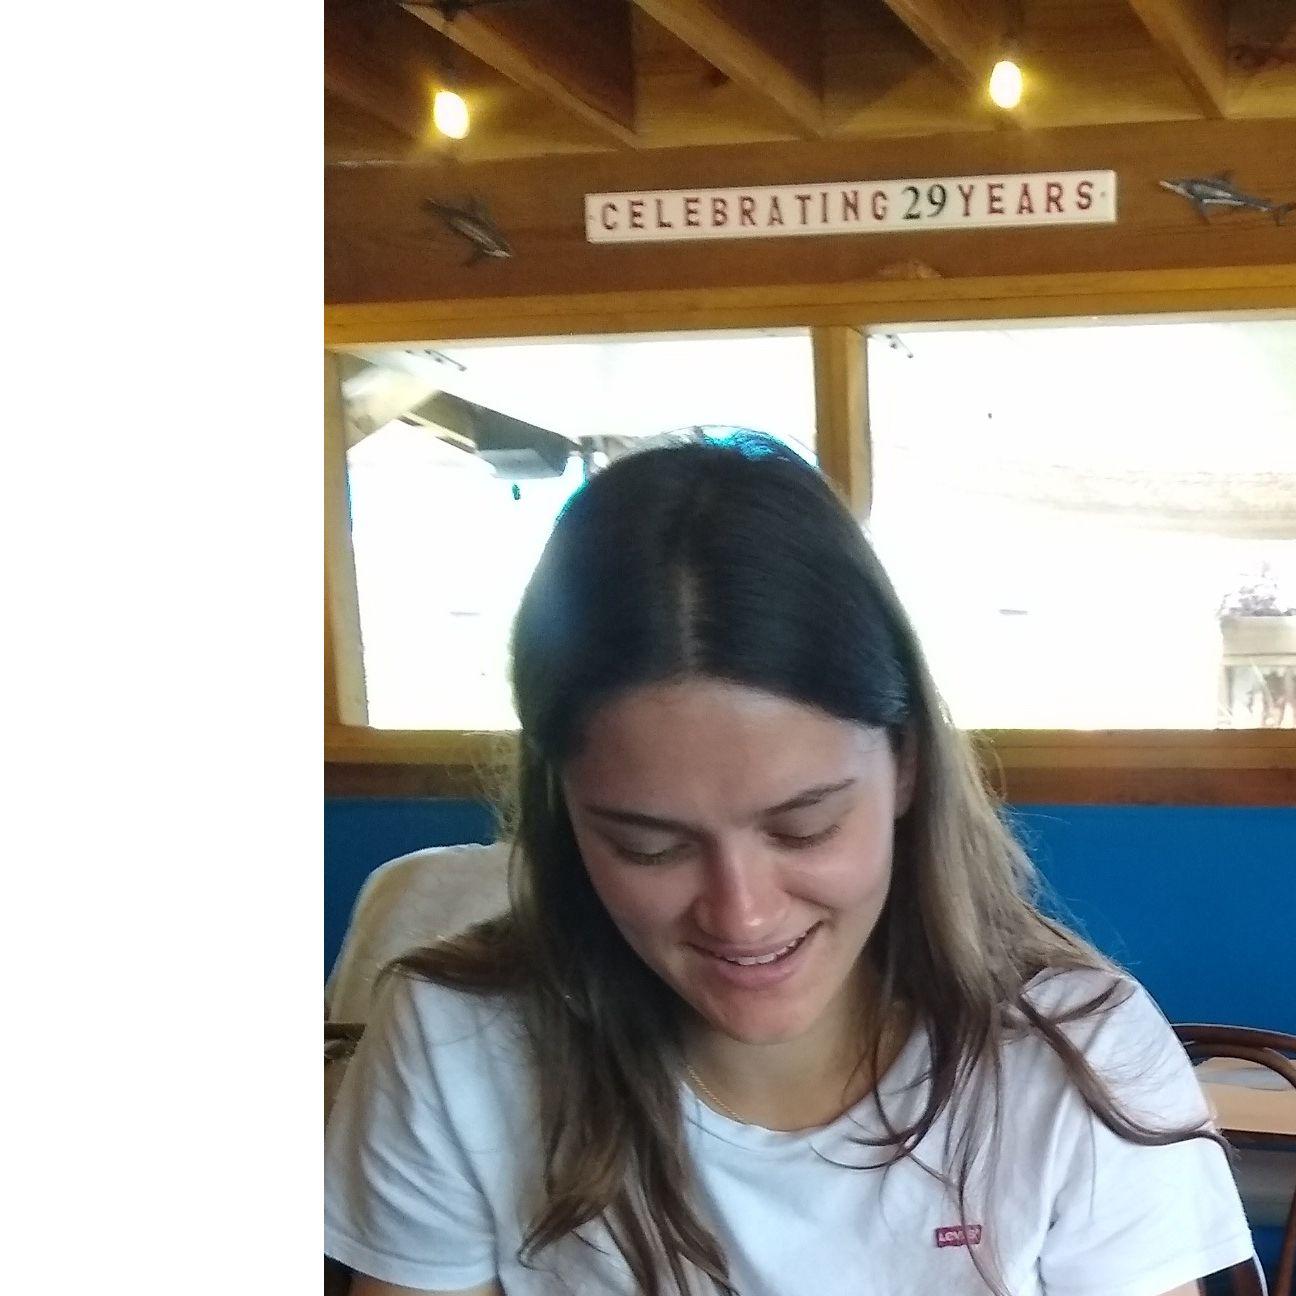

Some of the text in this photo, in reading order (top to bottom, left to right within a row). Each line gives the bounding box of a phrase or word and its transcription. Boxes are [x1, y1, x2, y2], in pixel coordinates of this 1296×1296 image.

[602, 180, 1095, 231] CELEBRATING 29 YEARS
